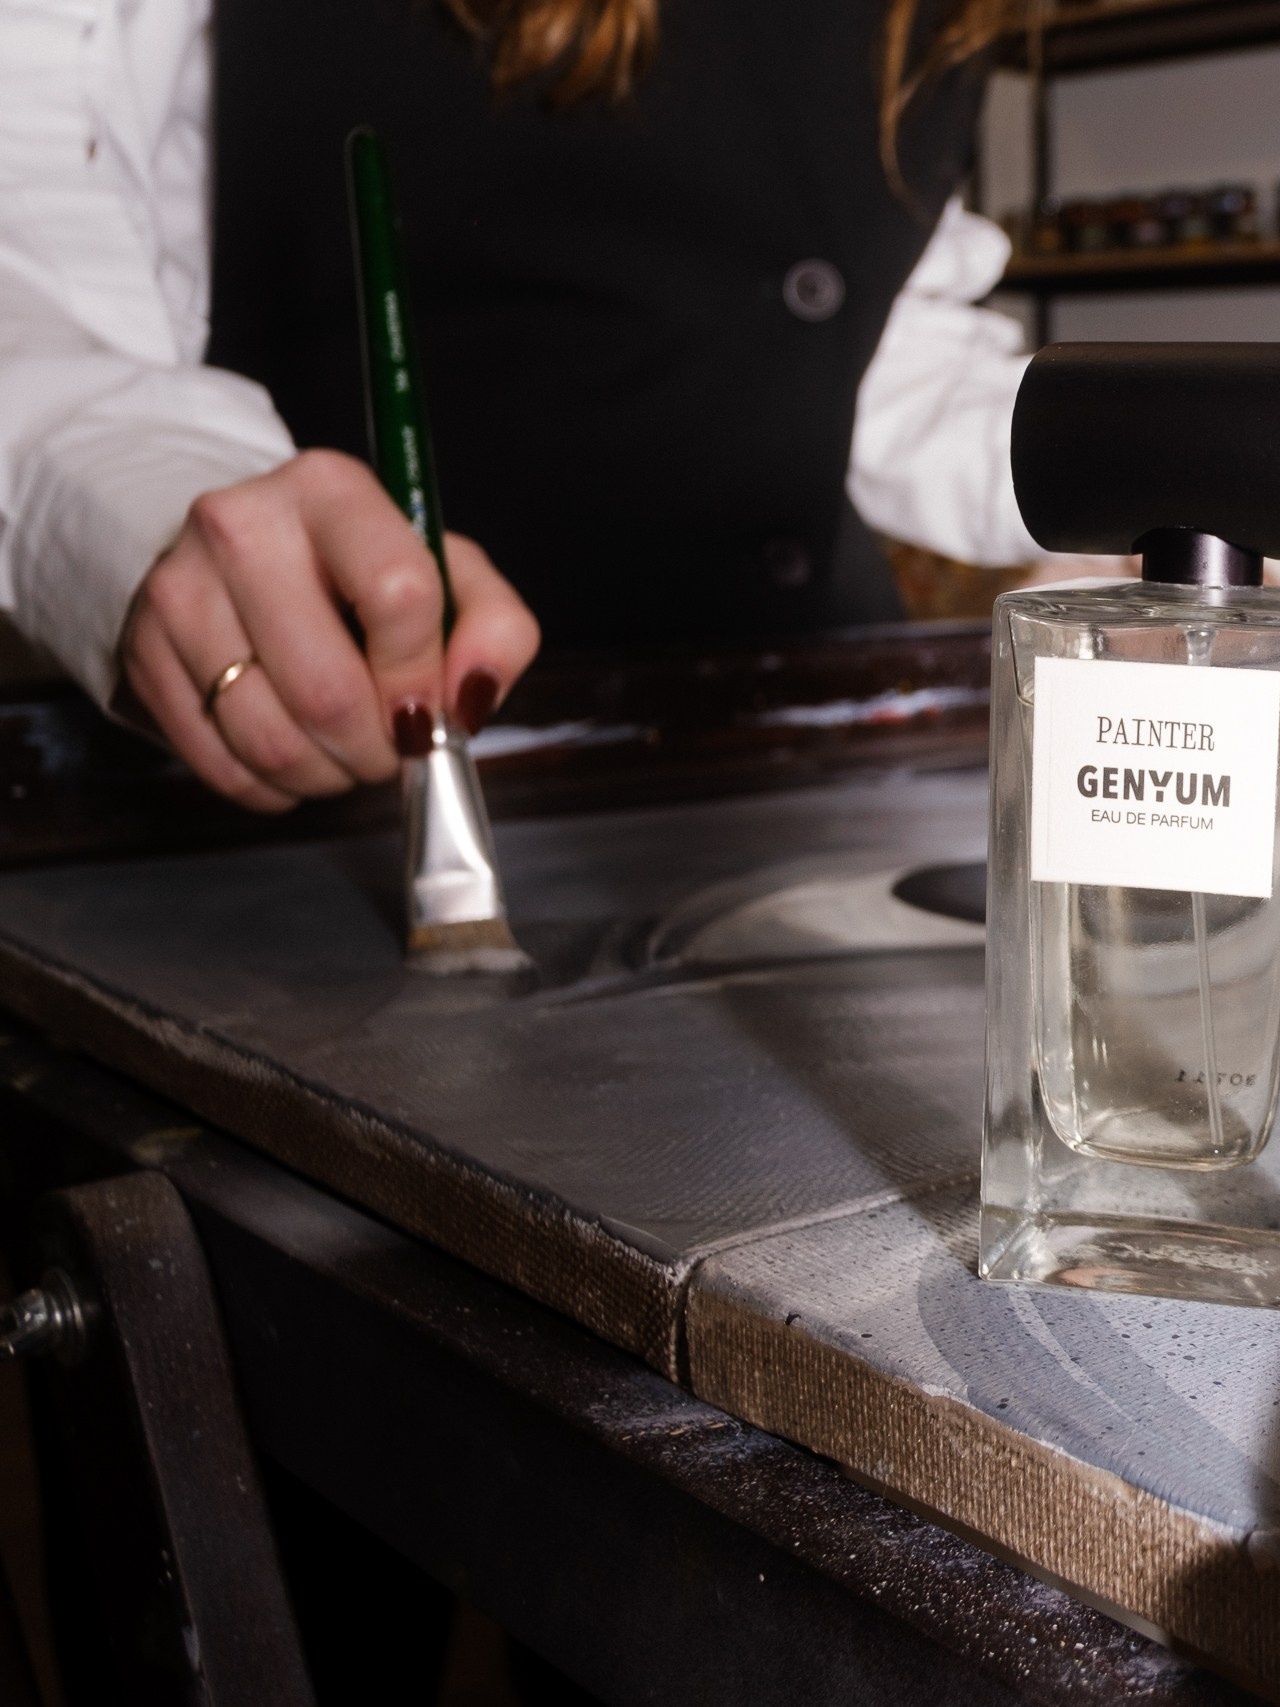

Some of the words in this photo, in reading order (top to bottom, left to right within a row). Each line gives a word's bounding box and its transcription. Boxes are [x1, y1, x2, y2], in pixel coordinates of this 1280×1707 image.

[1096, 716, 1215, 751] PAINTER
[1077, 765, 1231, 808] GENYUM
[1091, 809, 1121, 824] EAU
[1126, 811, 1146, 826] DE
[1151, 813, 1214, 831] PARFUM
